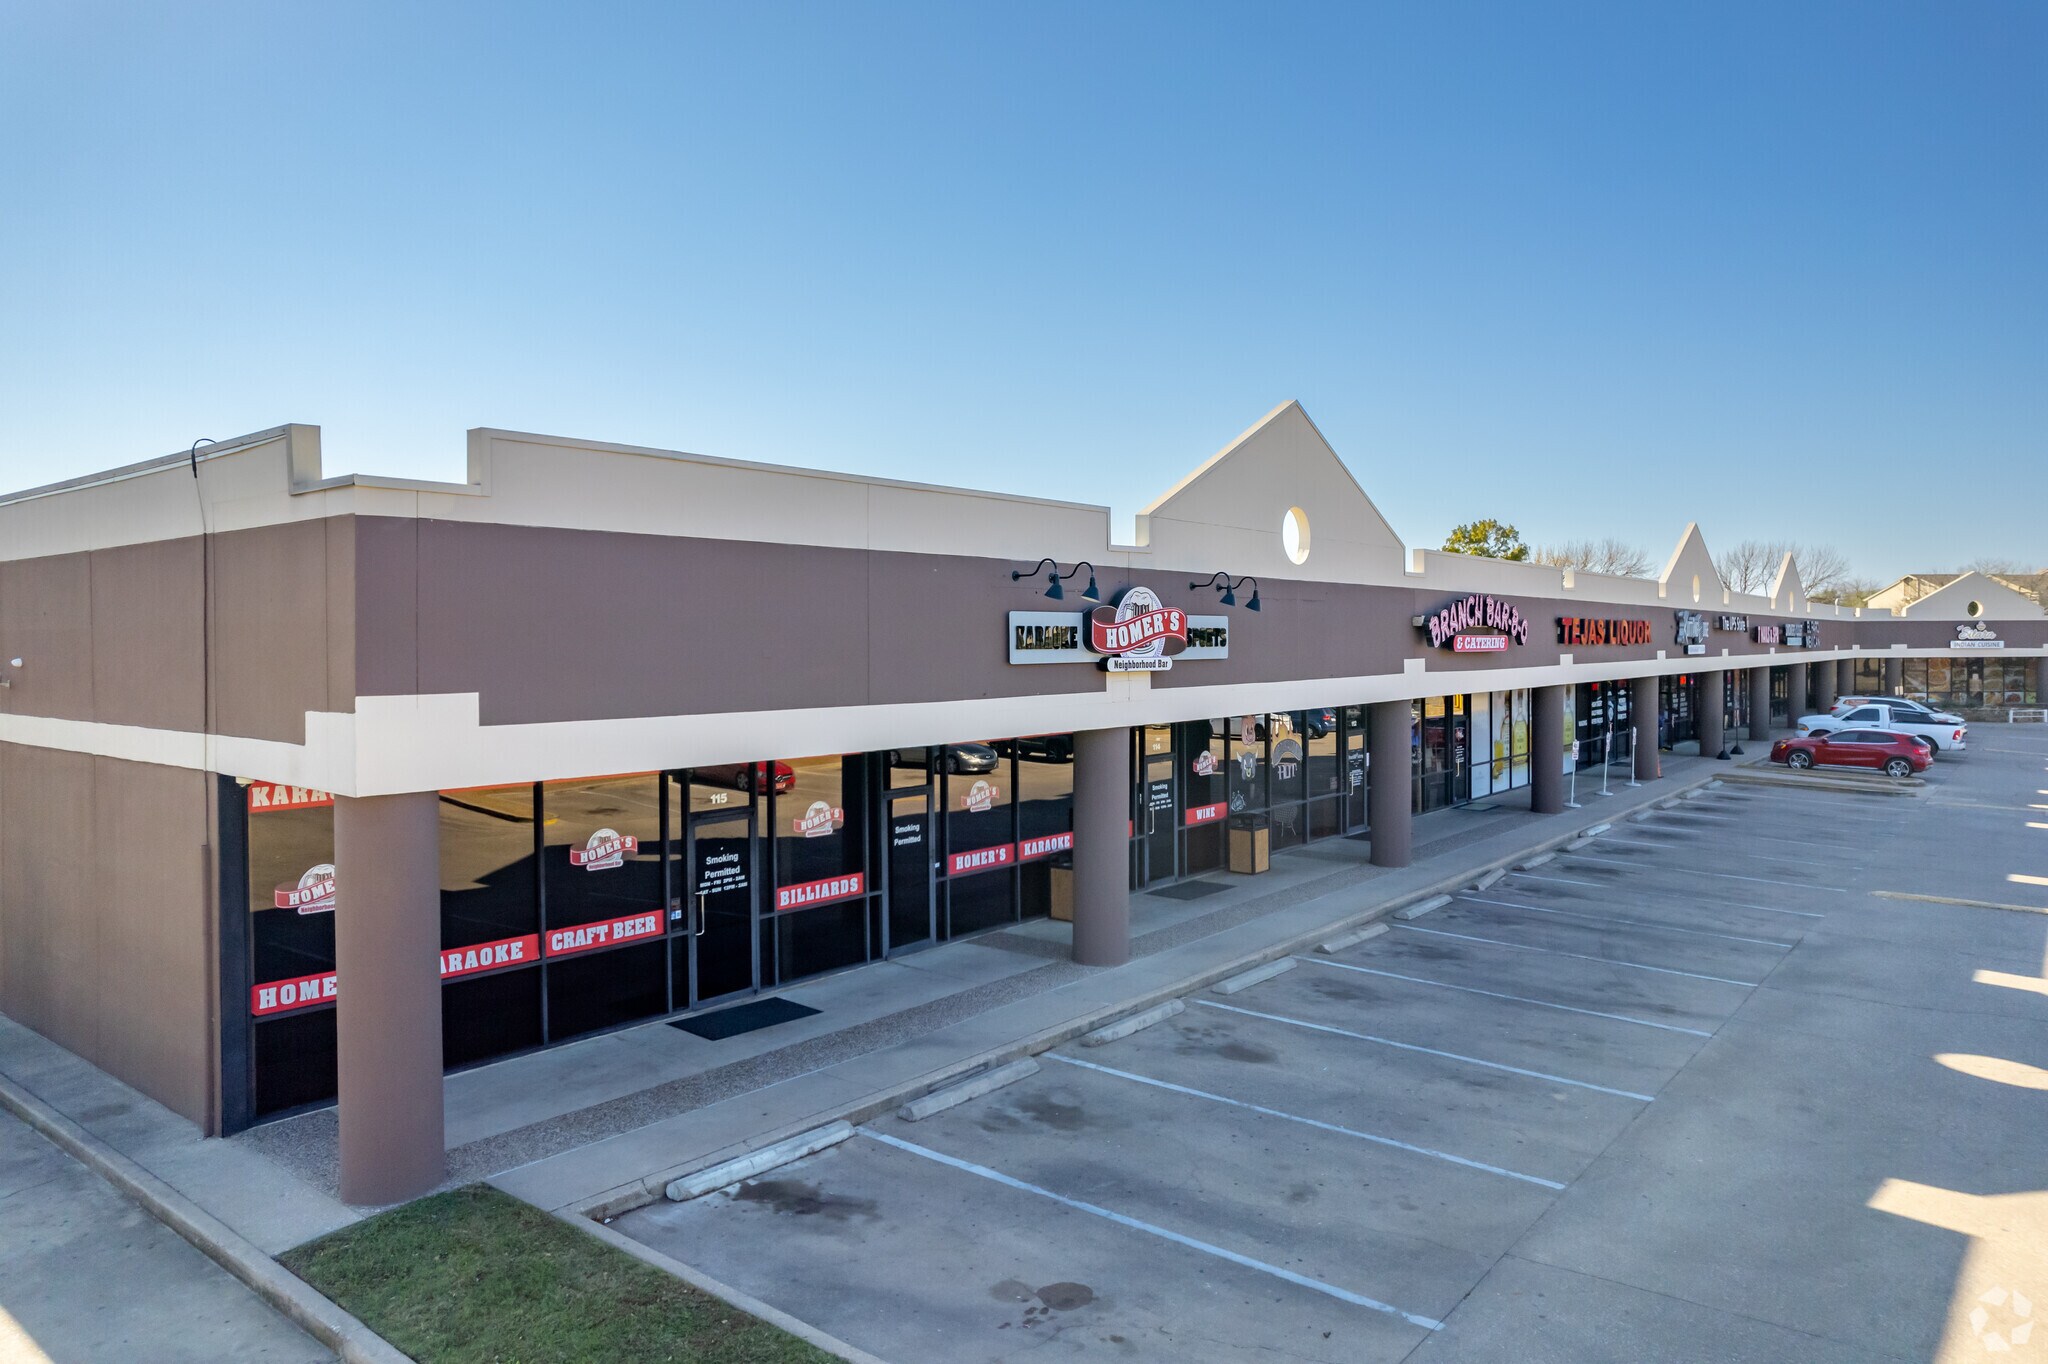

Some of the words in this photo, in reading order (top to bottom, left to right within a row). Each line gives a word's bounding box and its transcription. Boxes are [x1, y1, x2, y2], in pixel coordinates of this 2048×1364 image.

[1106, 612, 1180, 648] HOMER'S
[1429, 594, 1483, 648] BRANCH
[1015, 625, 1078, 650] KARAOKE
[1562, 618, 1605, 646] TEJAS
[1610, 618, 1652, 646] LIQUOR
[1456, 637, 1463, 649] &
[1464, 637, 1506, 649] CATERING
[1113, 660, 1157, 671] Neighborhood
[1157, 660, 1169, 668] Bar
[966, 786, 997, 806] HOMER'S
[1152, 783, 1168, 791] Smoking
[711, 793, 728, 805] 115
[801, 808, 840, 831] HOMER'S
[1196, 806, 1216, 820] WINE
[895, 824, 920, 834] Smoking
[580, 837, 633, 863] HOMER'S
[894, 835, 921, 846] Permitted
[1024, 835, 1071, 856] KARAOKE
[706, 853, 739, 865] Smoking
[956, 848, 1006, 870] HOMER'S
[705, 865, 740, 879] Permitted
[780, 877, 859, 907] BILLIARDS
[551, 924, 609, 951] CRAFT
[613, 915, 656, 940] BEER
